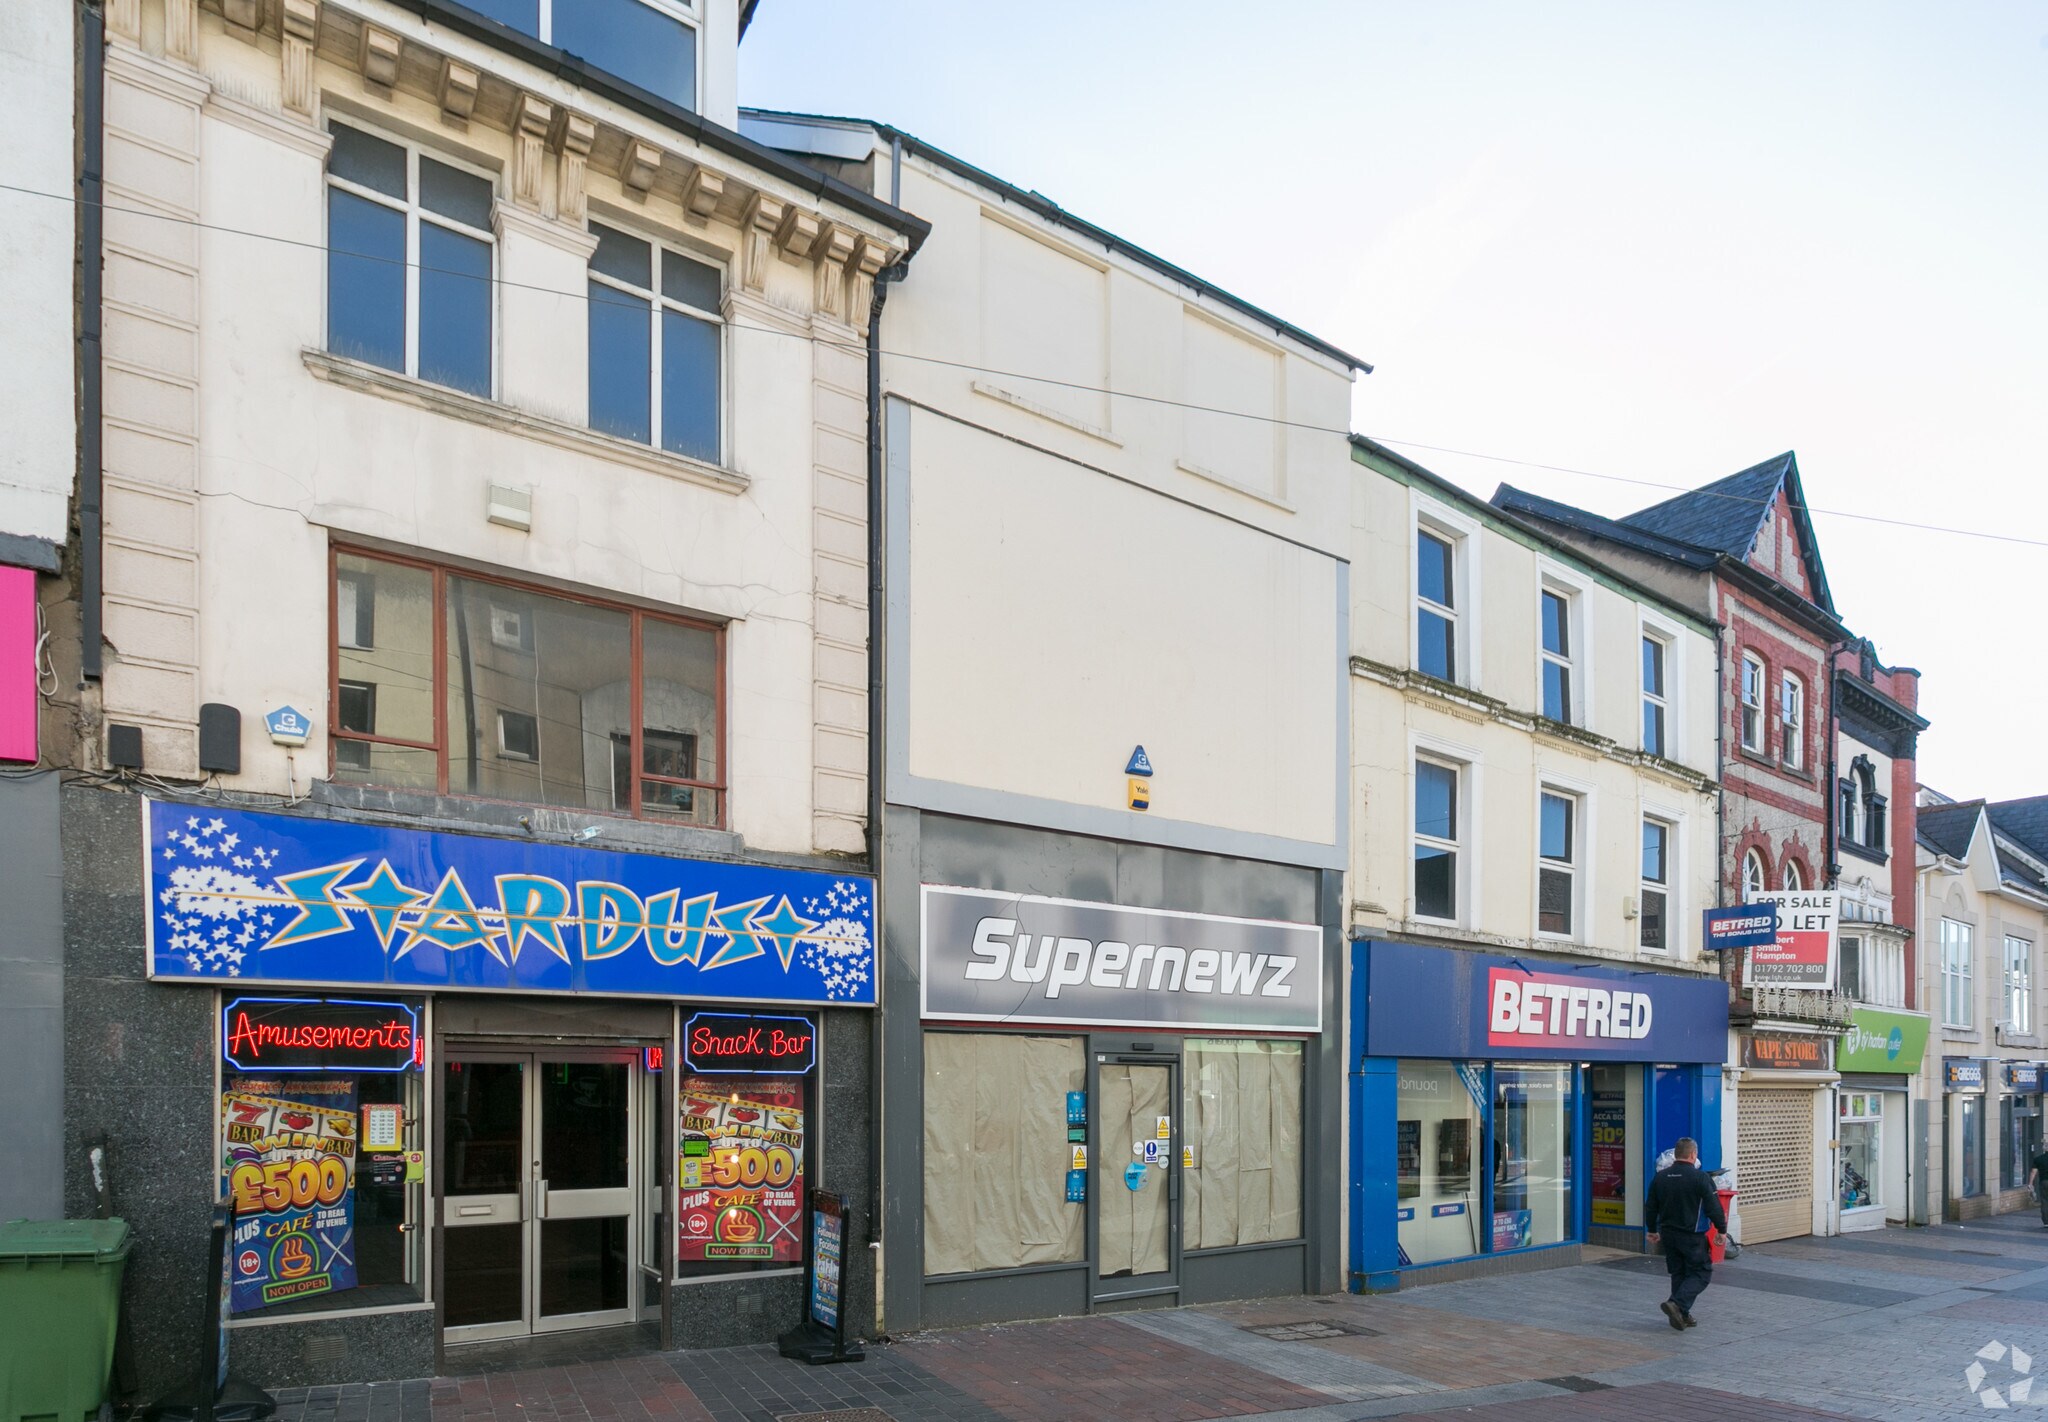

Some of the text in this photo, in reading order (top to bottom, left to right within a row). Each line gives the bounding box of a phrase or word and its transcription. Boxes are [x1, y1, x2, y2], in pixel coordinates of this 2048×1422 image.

[274, 724, 304, 734] Chubb
[1135, 785, 1149, 795] Yale
[1790, 896, 1832, 908] SALE
[260, 857, 822, 974] STARDUST
[1793, 915, 1831, 930] LET
[1711, 916, 1772, 932] BETFRED
[1727, 929, 1752, 937] BONUS
[1753, 927, 1771, 935] KING
[1776, 935, 1795, 944] bert
[1756, 944, 1783, 952] Smith
[964, 916, 1299, 999] Supernewz
[1756, 951, 1797, 961] Hampton
[1754, 964, 1824, 973] 01792 702 800
[1490, 978, 1653, 1040] BETFRED
[228, 1012, 411, 1057] Amusements
[769, 1029, 811, 1057] Bar
[1755, 1039, 1819, 1060] VAPE STORE
[1957, 1066, 1982, 1082] GREGGS
[685, 1117, 711, 1131] BAR
[231, 1124, 260, 1141] BAR
[703, 1124, 775, 1140] WIN
[773, 1132, 799, 1147] BAR
[250, 1132, 329, 1154] WIN
[326, 1140, 352, 1155] BAR
[271, 1147, 315, 1161] UP TO
[228, 1153, 350, 1215] £500
[682, 1190, 710, 1211] PLUS
[714, 1191, 762, 1208] CAFÉ
[765, 1191, 794, 1199] TO REAR
[763, 1199, 796, 1207] OF VENUE
[317, 1208, 346, 1220] TO REAR
[265, 1212, 314, 1238] CAFÉ
[315, 1217, 348, 1229] OF VENUE
[690, 1219, 705, 1227] 18+
[711, 1247, 768, 1255] NOW OPEN
[242, 1258, 258, 1268] 18+
[269, 1278, 327, 1297] NOW OPEN
